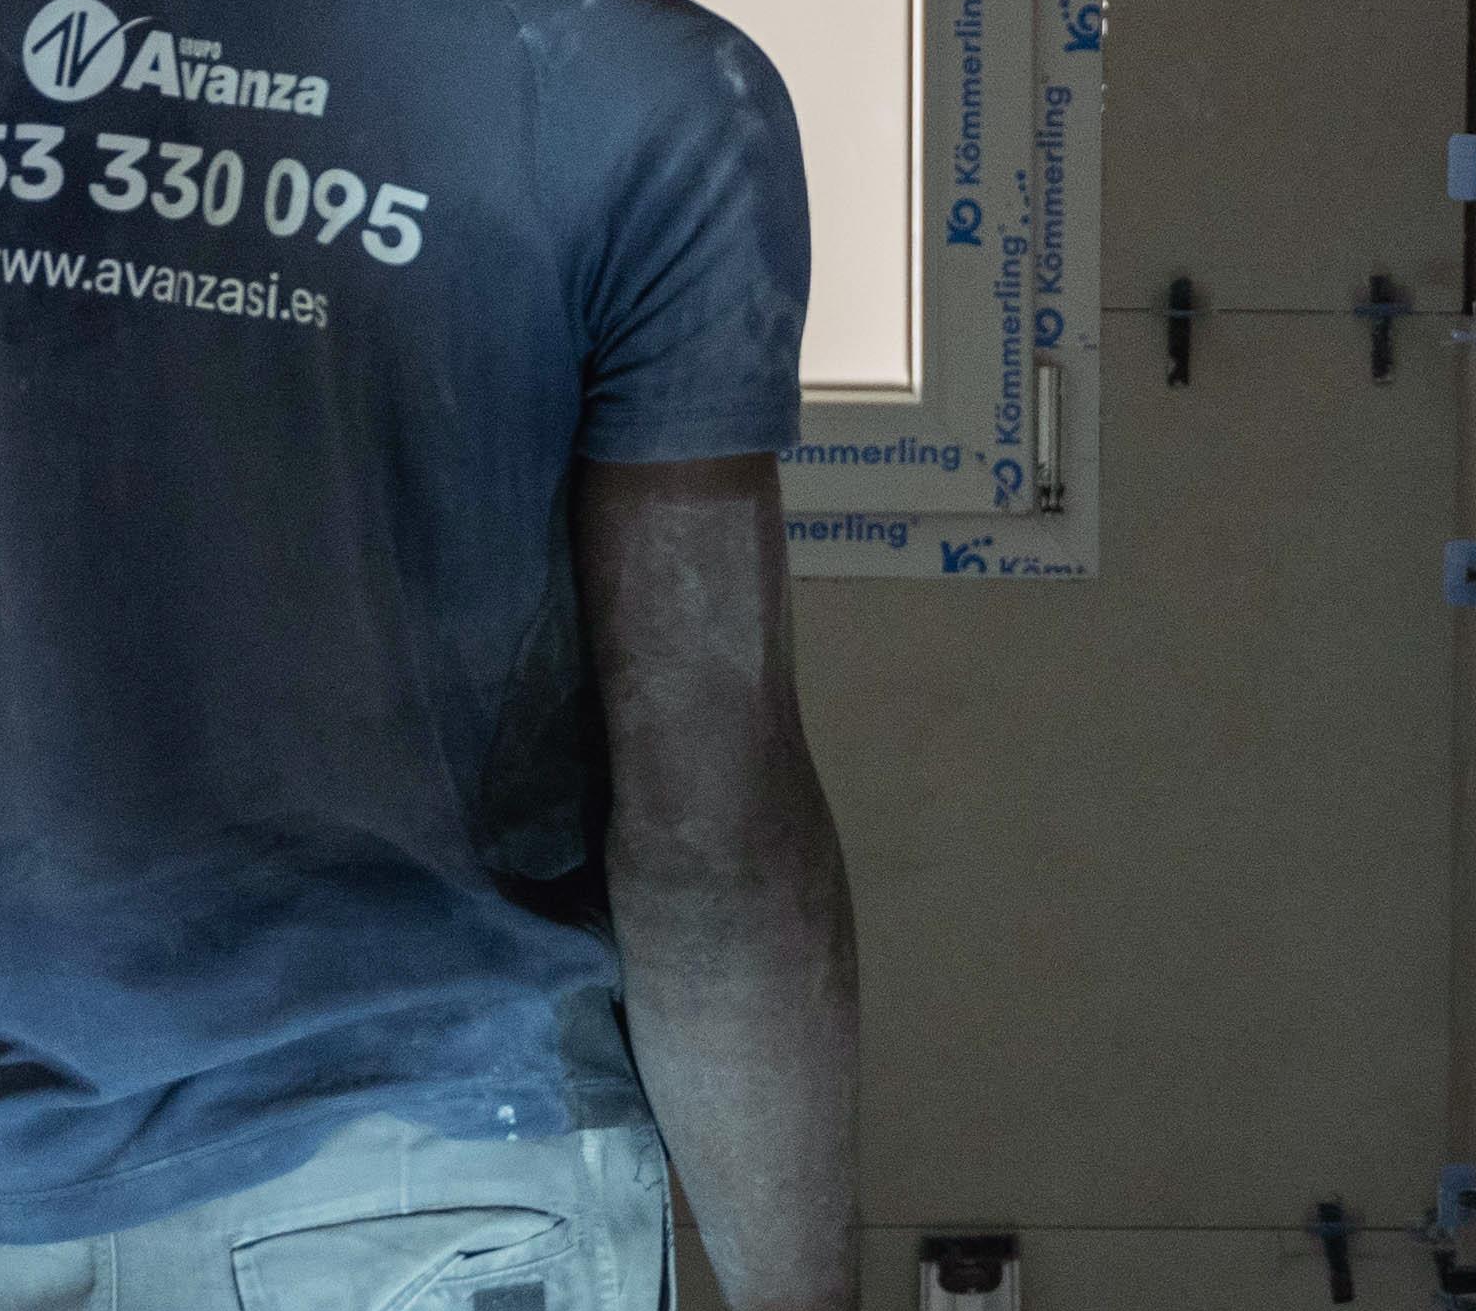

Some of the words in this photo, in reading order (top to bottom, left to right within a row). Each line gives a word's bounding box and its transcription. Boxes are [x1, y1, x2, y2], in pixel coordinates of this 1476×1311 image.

[121, 29, 330, 117] Avanza
[88, 132, 245, 227] 330
[264, 156, 430, 266] 095
[1036, 86, 1072, 294] Kömmerling
[994, 235, 1028, 446] Kömmerling
